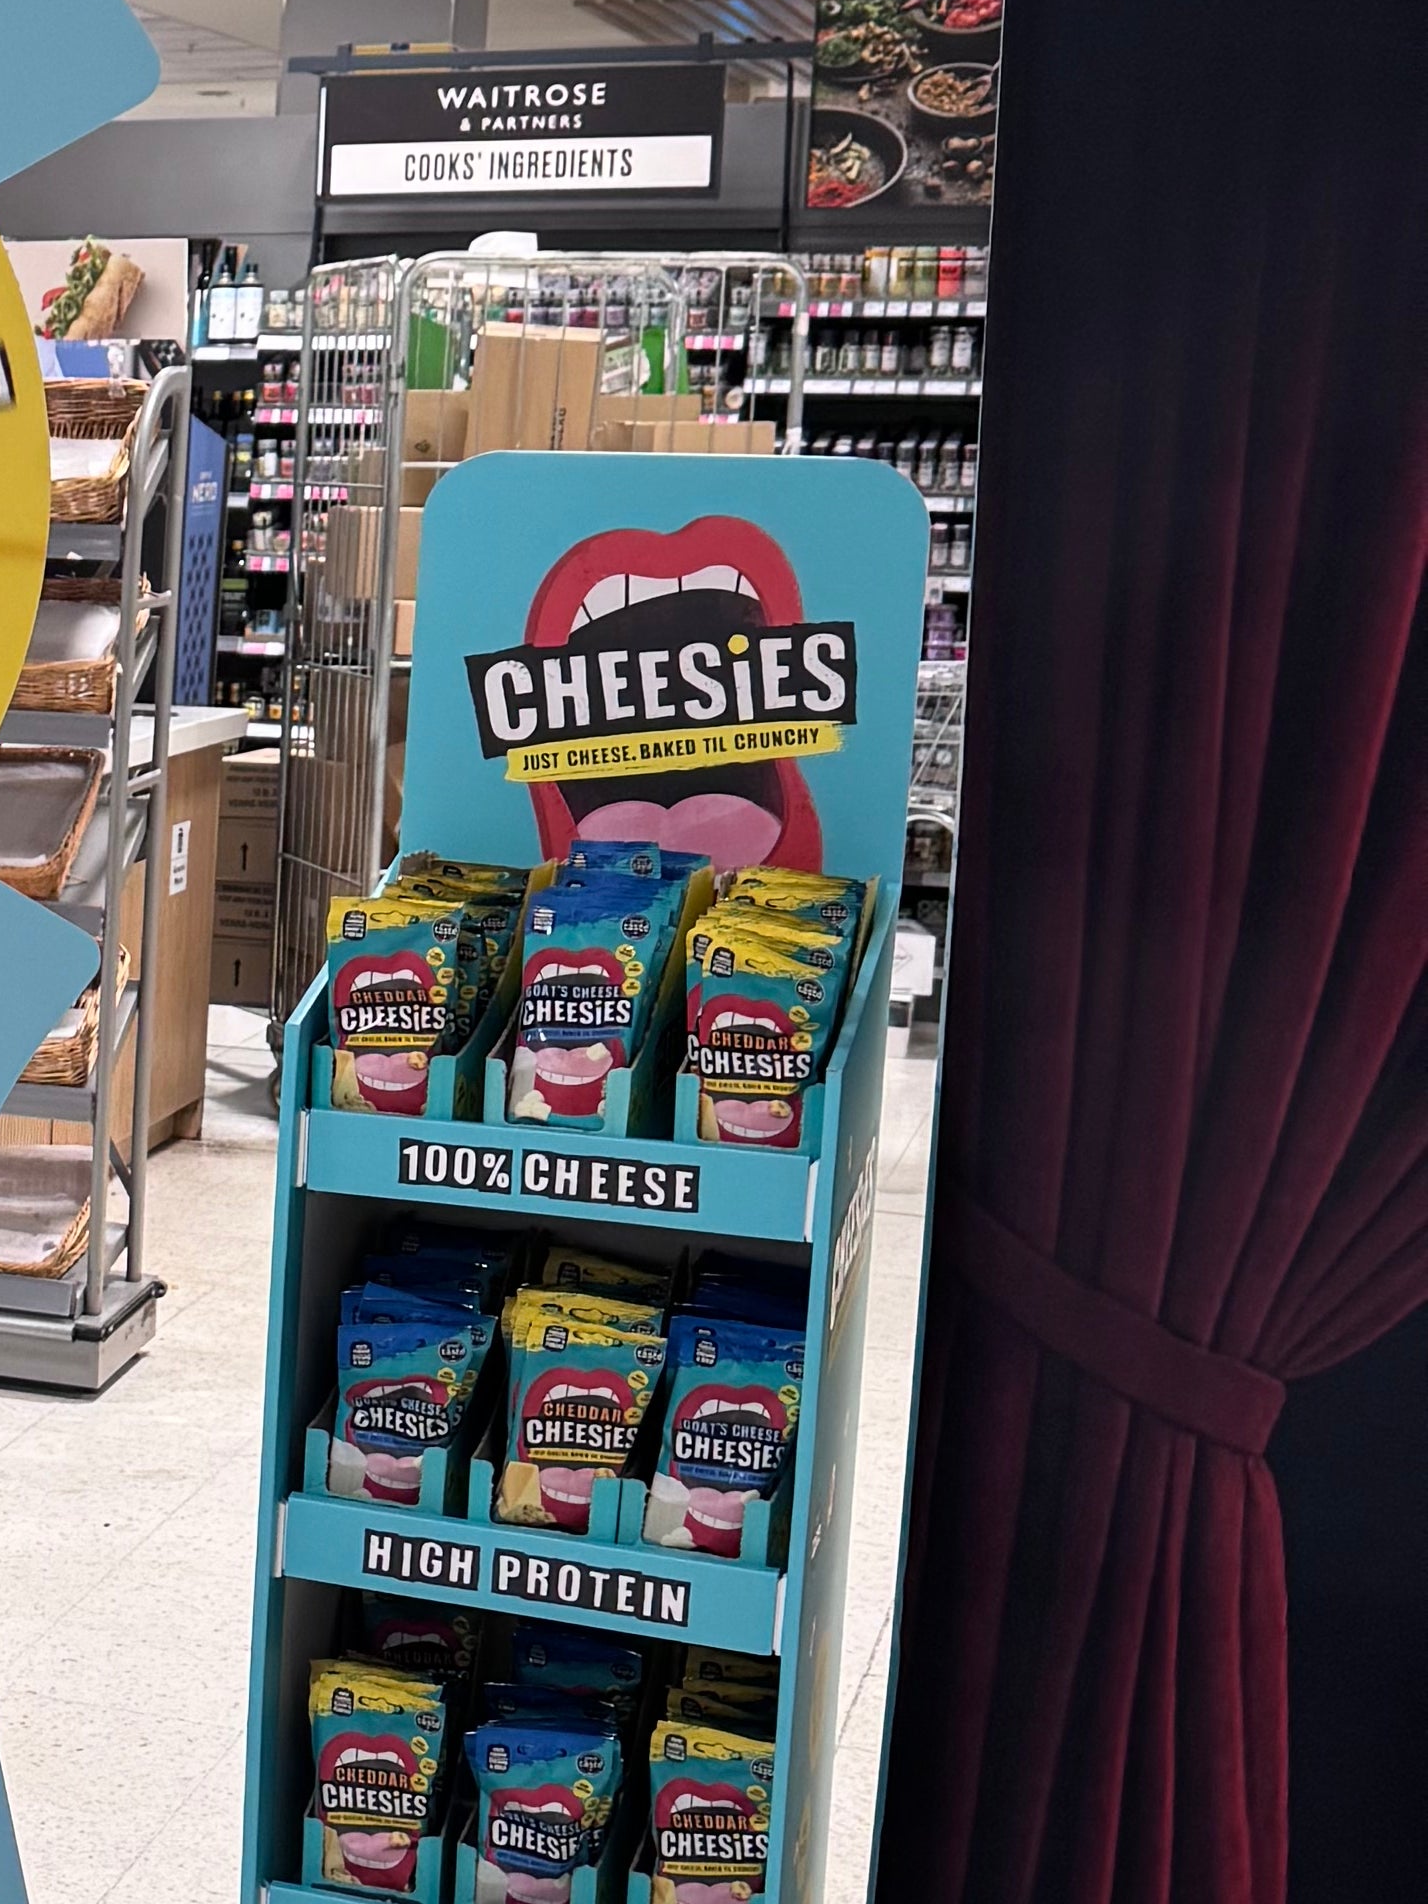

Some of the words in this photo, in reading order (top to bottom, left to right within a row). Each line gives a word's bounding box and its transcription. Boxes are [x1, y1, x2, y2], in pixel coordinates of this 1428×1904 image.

[437, 82, 607, 110] WAITROSE
[459, 117, 471, 132] &
[480, 114, 583, 132] PARTNERS
[404, 153, 484, 182] COOKS'
[489, 149, 634, 179] INGREDIENTS
[523, 752, 561, 772] JUST
[640, 739, 697, 761] BAKED
[703, 736, 727, 754] TIL
[734, 728, 820, 750] CRUNCHY
[351, 989, 427, 1004] CHEDDAR
[572, 986, 619, 998] CHEESE
[712, 1032, 791, 1050] CHEDDAR
[402, 1144, 510, 1188] 100%
[525, 1153, 694, 1209] CHEESE
[544, 1403, 622, 1423] CHEDDAR
[732, 1424, 780, 1442] CHEESE
[367, 1534, 474, 1585] HIGH
[498, 1554, 686, 1622] PROTEIN
[335, 1767, 408, 1788] CHEDDAR
[673, 1813, 748, 1830] CHEDDAR
